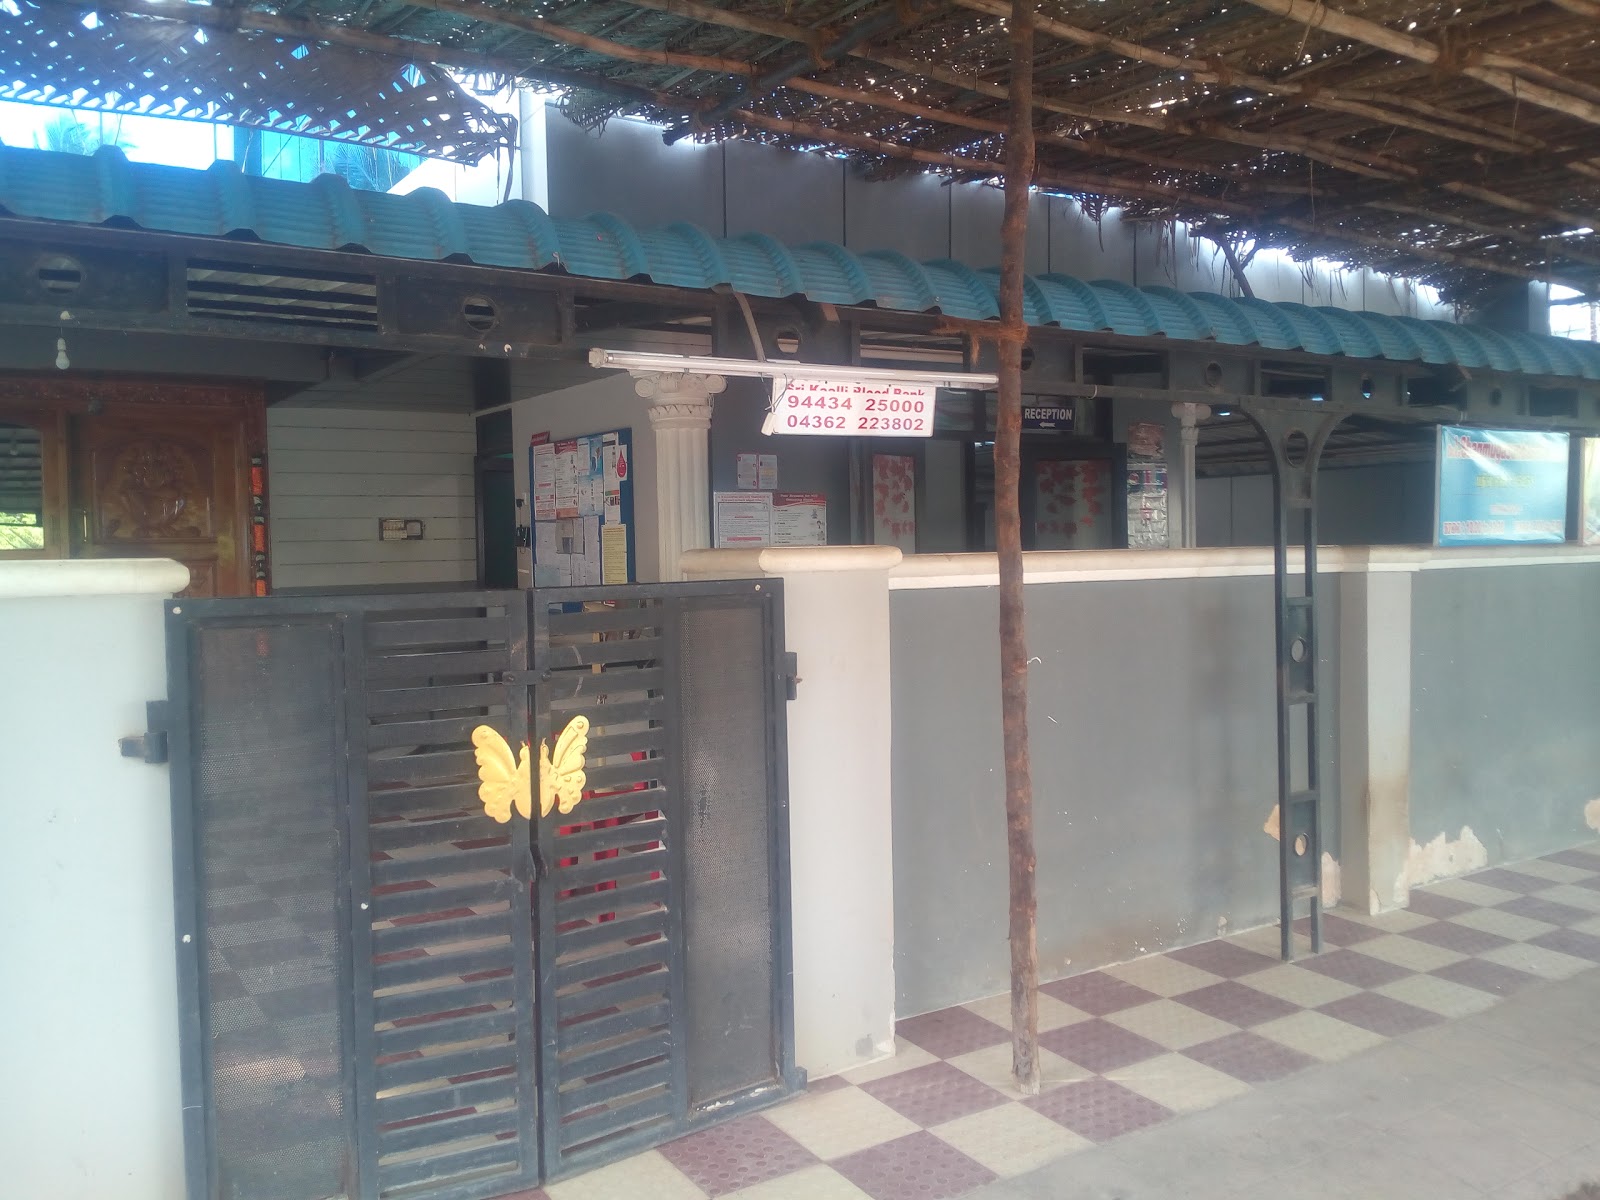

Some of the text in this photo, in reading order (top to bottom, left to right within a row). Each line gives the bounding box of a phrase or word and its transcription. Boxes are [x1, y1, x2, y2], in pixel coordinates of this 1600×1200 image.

[787, 395, 925, 413] 94434 25000
[1024, 408, 1073, 420] RECEPTION
[787, 415, 924, 431] 04362 223802
